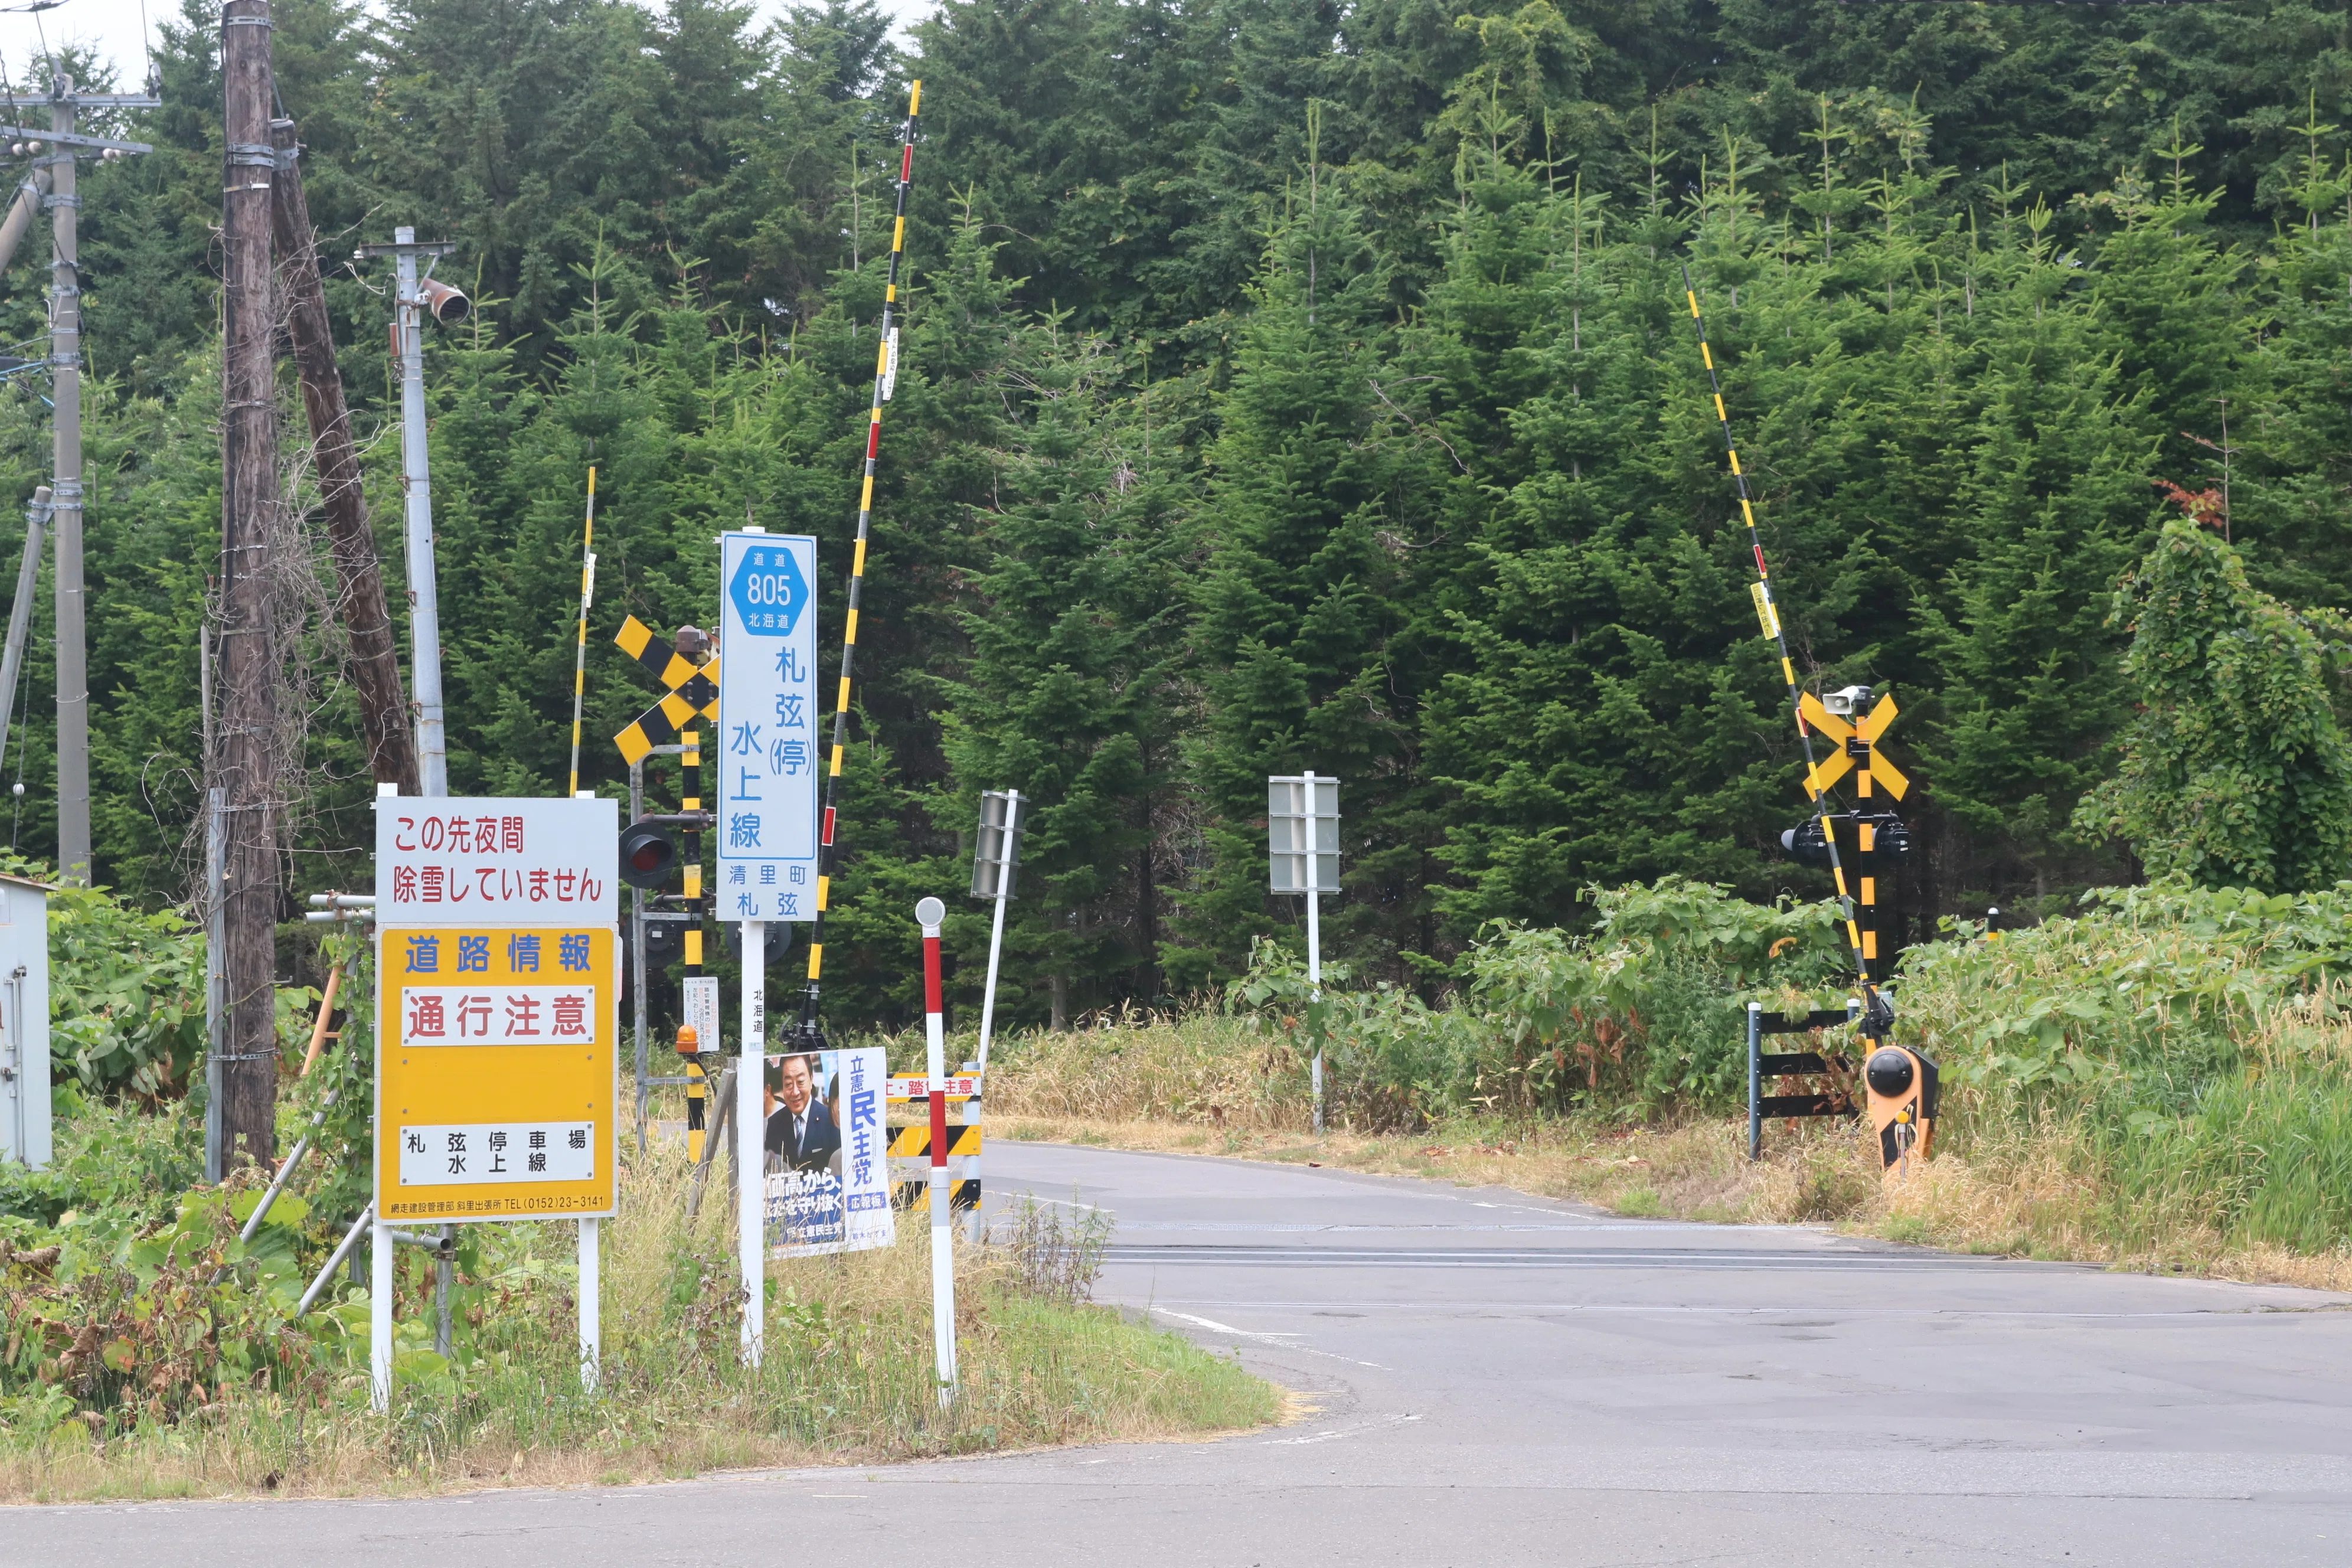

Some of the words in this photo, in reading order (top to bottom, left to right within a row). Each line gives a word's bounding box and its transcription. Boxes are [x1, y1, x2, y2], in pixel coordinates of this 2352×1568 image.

[753, 552, 786, 567] 道道
[747, 573, 791, 606] 805
[748, 612, 789, 629] 北海道
[730, 720, 763, 848] 水上線
[396, 815, 524, 854] この先夜間
[393, 865, 602, 903] 除雪していません
[729, 865, 806, 886] 清里町
[737, 891, 799, 917] 札弦
[405, 933, 592, 974] 道路情報
[408, 994, 587, 1038] 通行注意
[753, 989, 763, 1033] 北海道
[850, 1055, 876, 1188] 立憲民主党
[407, 1129, 587, 1155] 札弦停車場
[447, 1151, 548, 1175] 水上線
[391, 1201, 455, 1214] 網走建設管理部
[457, 1199, 501, 1211] 斜里出張所
[851, 1194, 882, 1210] 広報板
